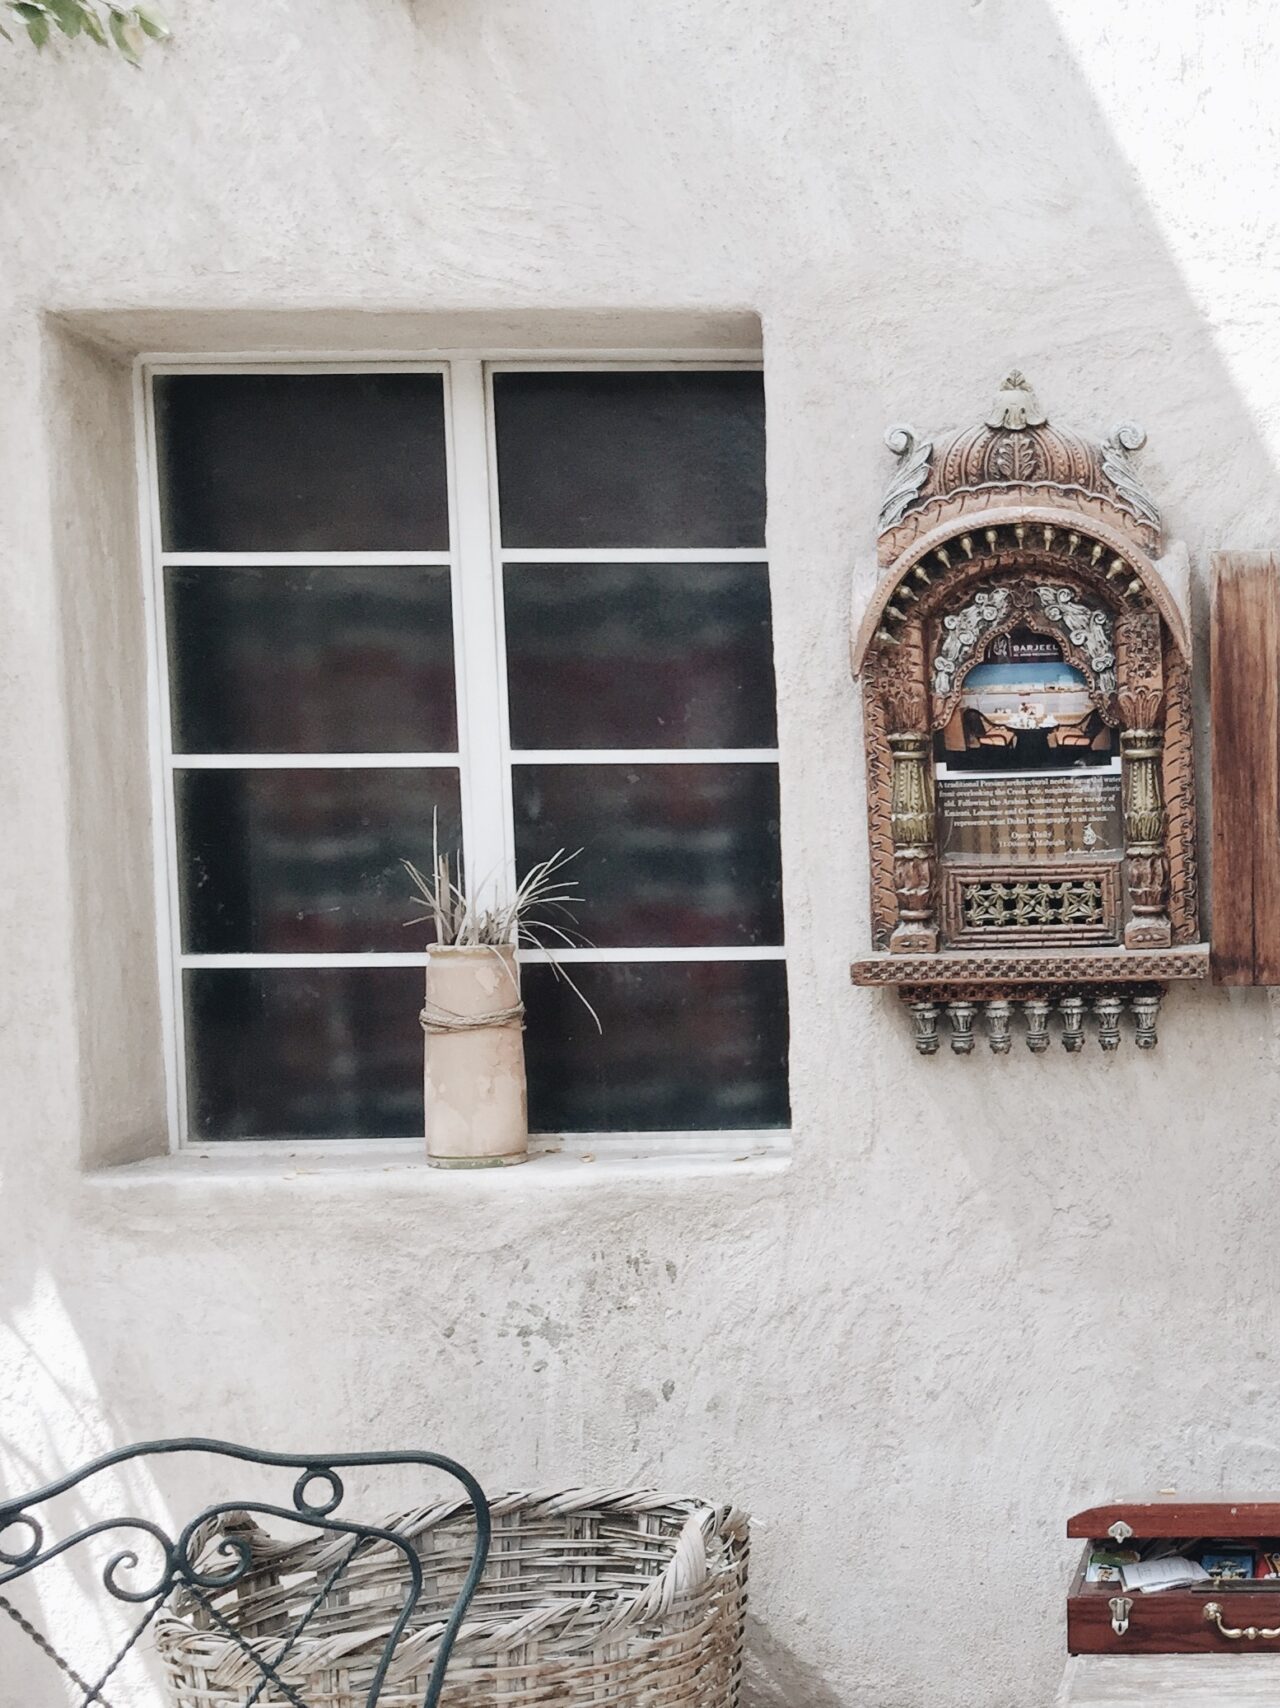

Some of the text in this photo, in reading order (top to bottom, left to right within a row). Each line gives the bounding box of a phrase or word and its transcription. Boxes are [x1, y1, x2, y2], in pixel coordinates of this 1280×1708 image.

[1013, 644, 1058, 652] BARJEEL
[1011, 831, 1053, 841] Open Daily
